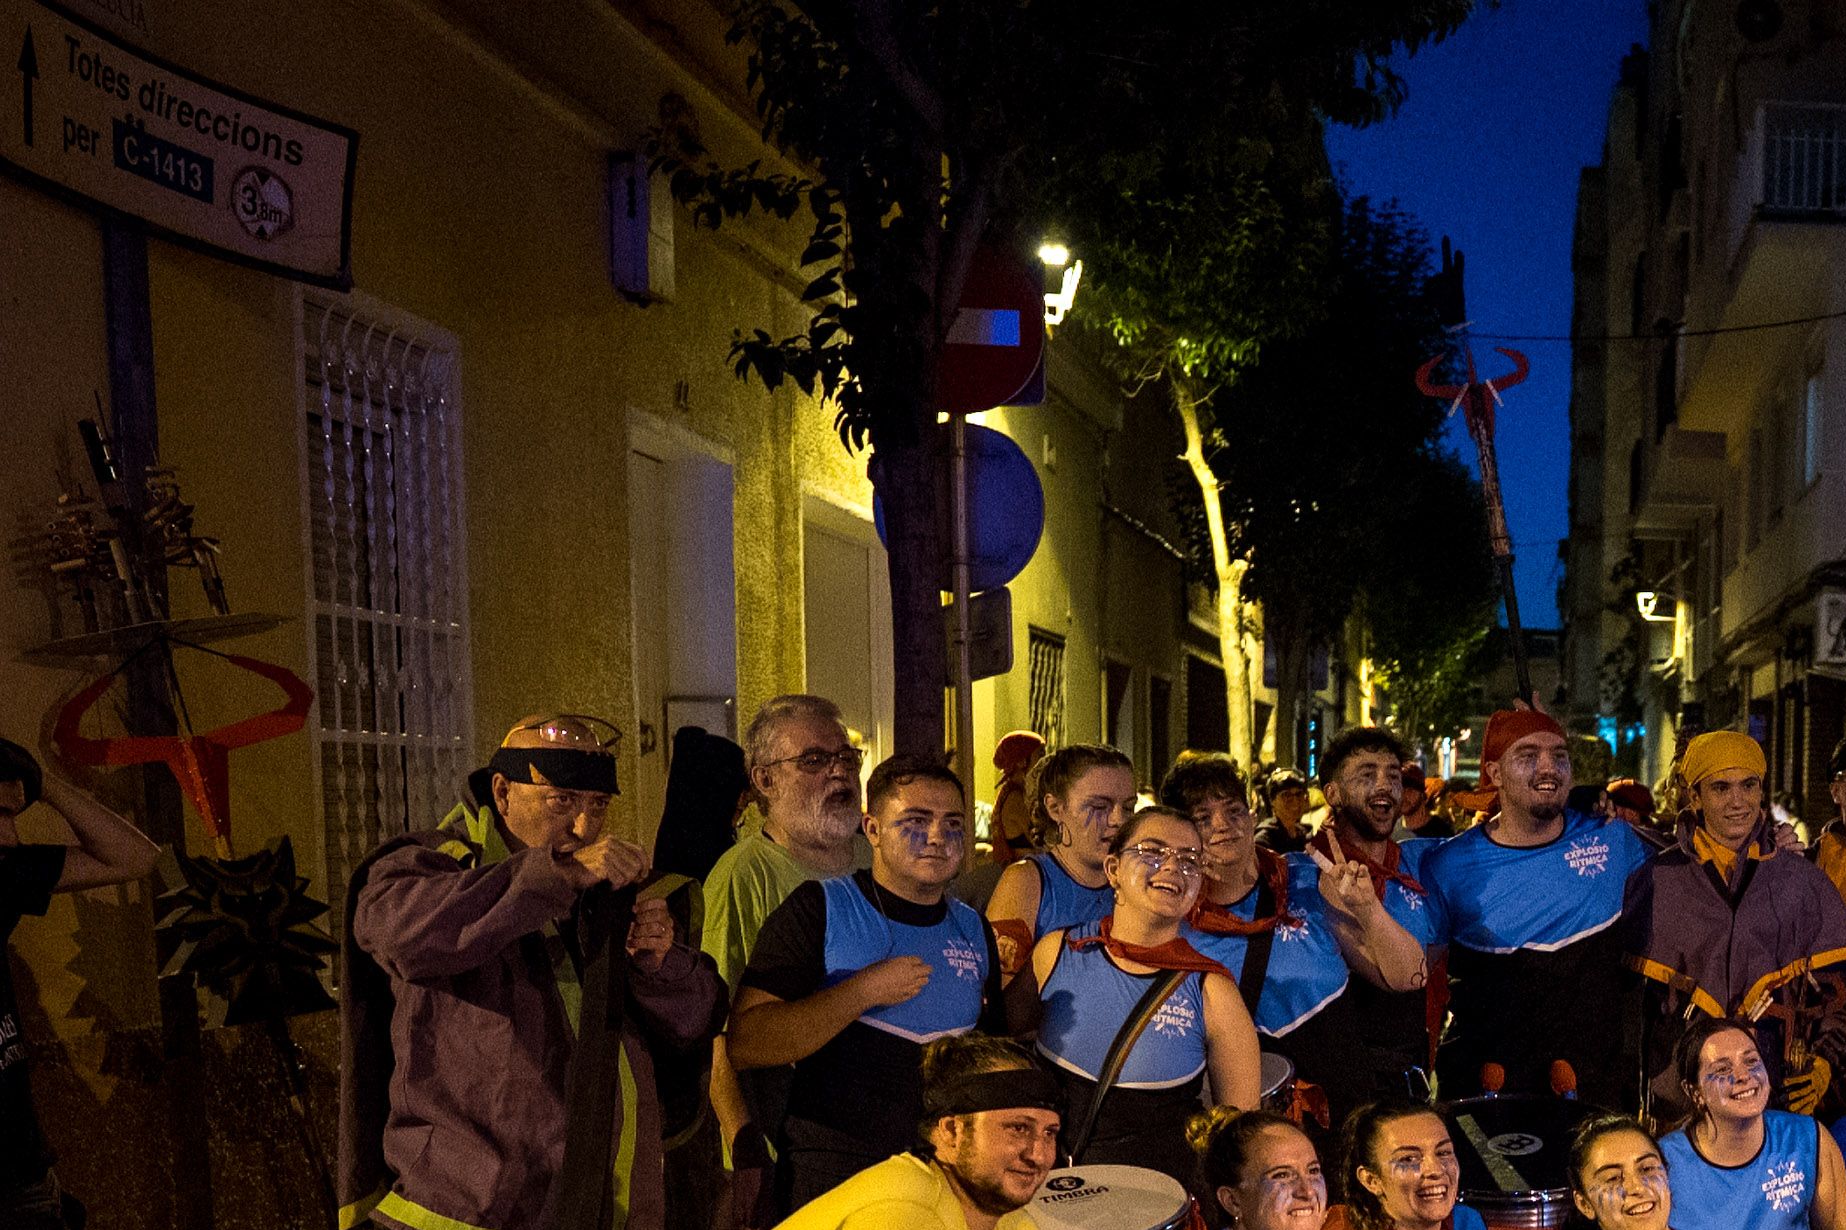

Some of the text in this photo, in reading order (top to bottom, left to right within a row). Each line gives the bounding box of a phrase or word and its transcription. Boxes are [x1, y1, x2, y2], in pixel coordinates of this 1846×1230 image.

[65, 35, 304, 167] Totes direccions
[63, 116, 204, 192] per C-1413
[1039, 1185, 1110, 1204] TIMBRA
